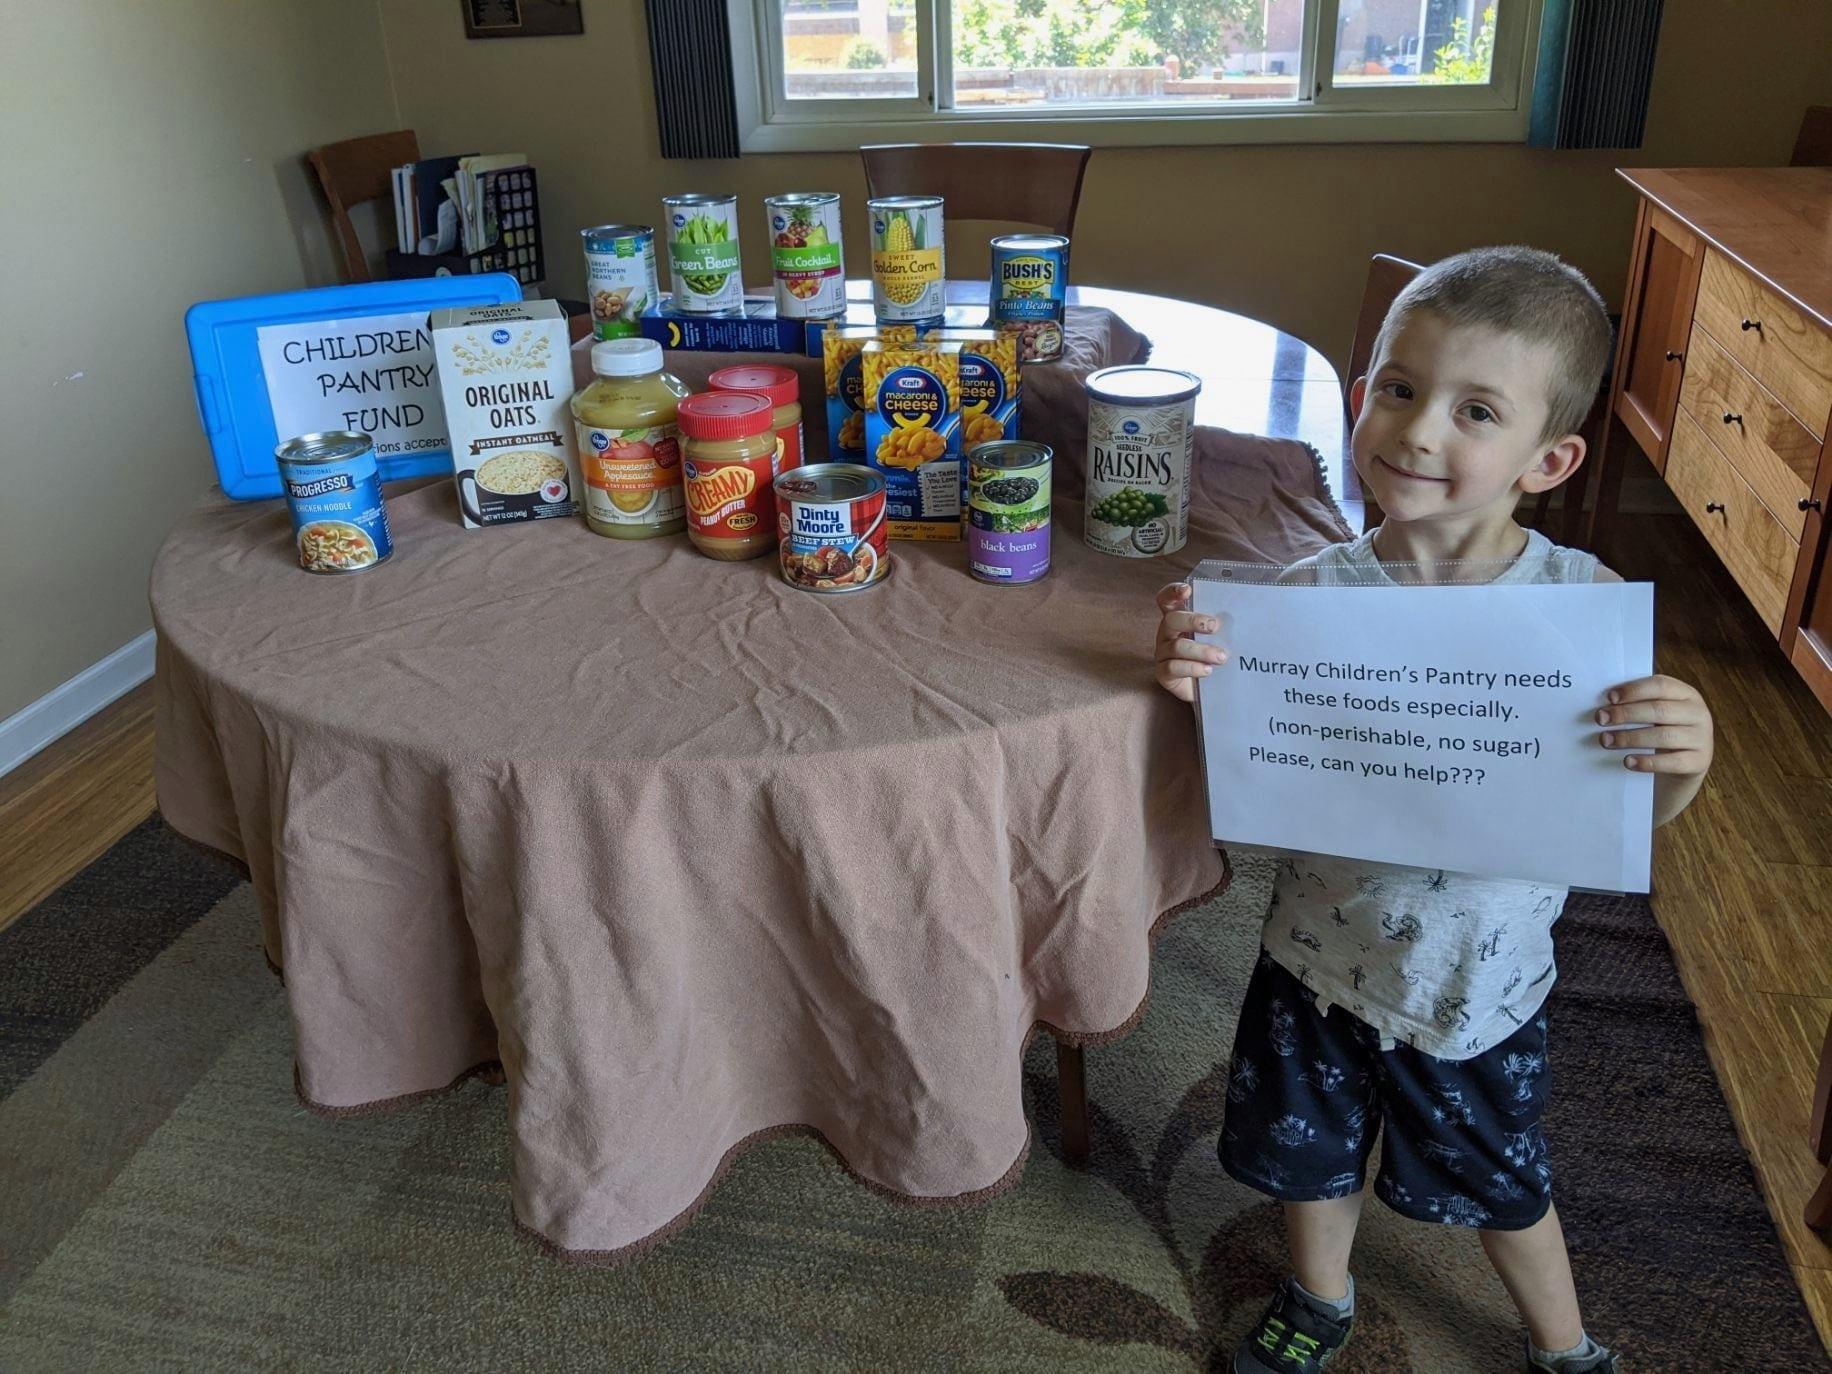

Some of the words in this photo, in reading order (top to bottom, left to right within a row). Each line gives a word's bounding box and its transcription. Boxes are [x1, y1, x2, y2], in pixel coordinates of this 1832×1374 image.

[671, 257, 703, 271] Green
[705, 256, 738, 270] Beans
[776, 257, 794, 267] Fruit
[795, 254, 832, 267] Cocktail
[874, 260, 907, 274] Golden
[909, 261, 937, 273] Corn
[592, 267, 626, 275] NORTHERN
[1003, 262, 1053, 280] BUSH'S
[469, 307, 524, 316] ORIGINAL
[1000, 301, 1023, 310] Pinto
[1025, 301, 1054, 310] Beans
[283, 328, 431, 364] CHILDREN
[316, 363, 434, 397] PANTRY
[902, 378, 920, 387] Kraft
[989, 380, 996, 388] &
[465, 379, 555, 408] ORIGINAL
[885, 391, 930, 400] macaroni
[960, 387, 996, 398] eese
[342, 404, 424, 432] FUND
[490, 405, 537, 429] OATS
[404, 436, 447, 451] accept
[477, 438, 513, 448] INSTANT
[515, 433, 555, 444] OATMEAL
[1116, 444, 1142, 452] SEEDLESS
[599, 460, 657, 471] Unsweetened
[1093, 445, 1172, 486] RAISINS
[604, 470, 654, 482] Applesauce
[291, 475, 349, 498] PROGRESSO
[688, 470, 749, 512] CREAMY
[296, 504, 323, 513] CHICKEN
[324, 501, 353, 512] NOODLE
[700, 511, 720, 526] PEANUT
[721, 500, 746, 518] BUTTER
[799, 506, 840, 523] Dinty
[729, 515, 756, 526] FRESH
[797, 519, 845, 534] Moore
[791, 535, 820, 546] BEEF
[821, 536, 855, 546] STEW
[980, 539, 1006, 552] black
[1009, 542, 1037, 552] beans
[1239, 655, 1310, 680] Murray
[1315, 662, 1419, 683] Children's
[1426, 667, 1498, 690] Pantry
[1504, 670, 1573, 688] needs
[1284, 688, 1337, 708] these
[1343, 692, 1401, 713] foods
[1407, 700, 1519, 722] especially.
[1269, 716, 1431, 751] (non-perishable,
[1439, 736, 1466, 750] no
[1472, 737, 1541, 759] sugar)
[1249, 746, 1316, 770] Please,
[1321, 756, 1355, 772] can
[1360, 761, 1398, 777] you
[1404, 762, 1486, 786] help???
